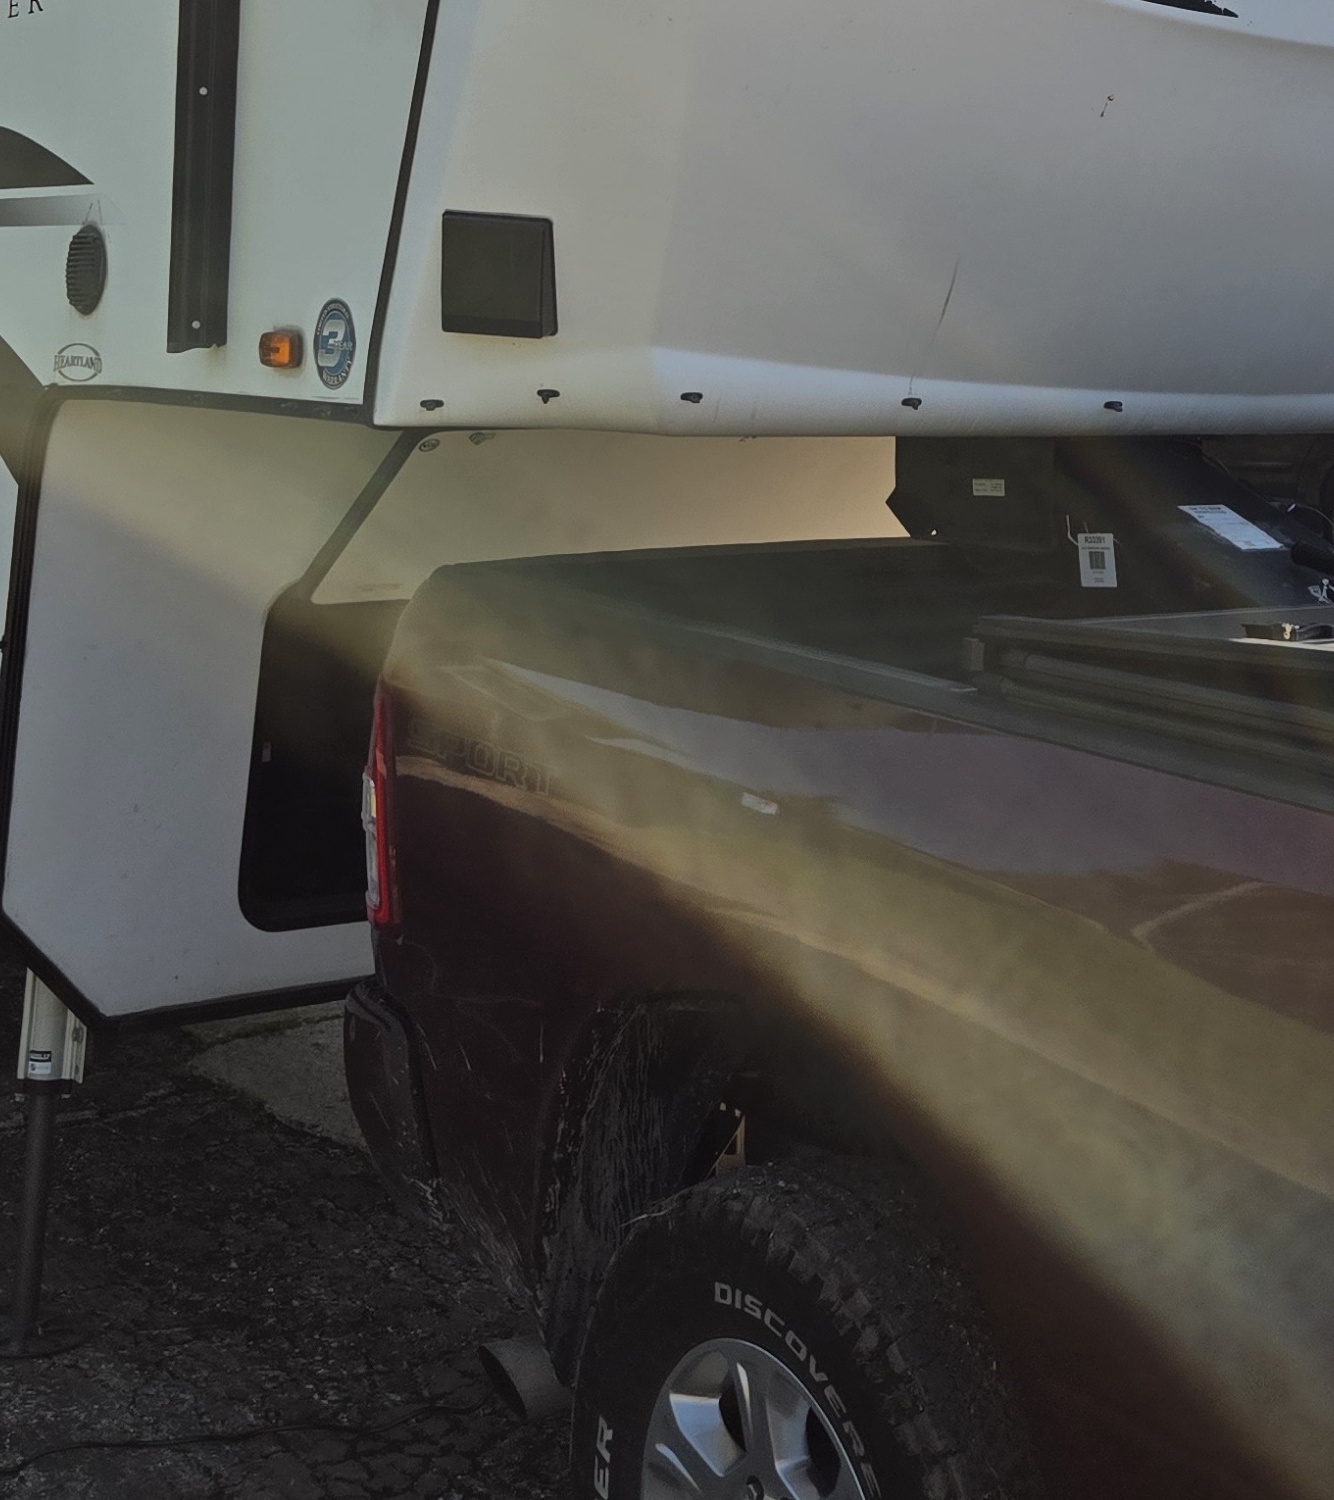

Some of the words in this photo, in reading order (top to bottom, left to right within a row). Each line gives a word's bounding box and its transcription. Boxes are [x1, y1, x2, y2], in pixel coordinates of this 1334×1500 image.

[53, 354, 103, 374] HEARTLAND
[317, 319, 347, 368] 3
[407, 719, 559, 796] SPORT
[593, 1412, 614, 1500] ER
